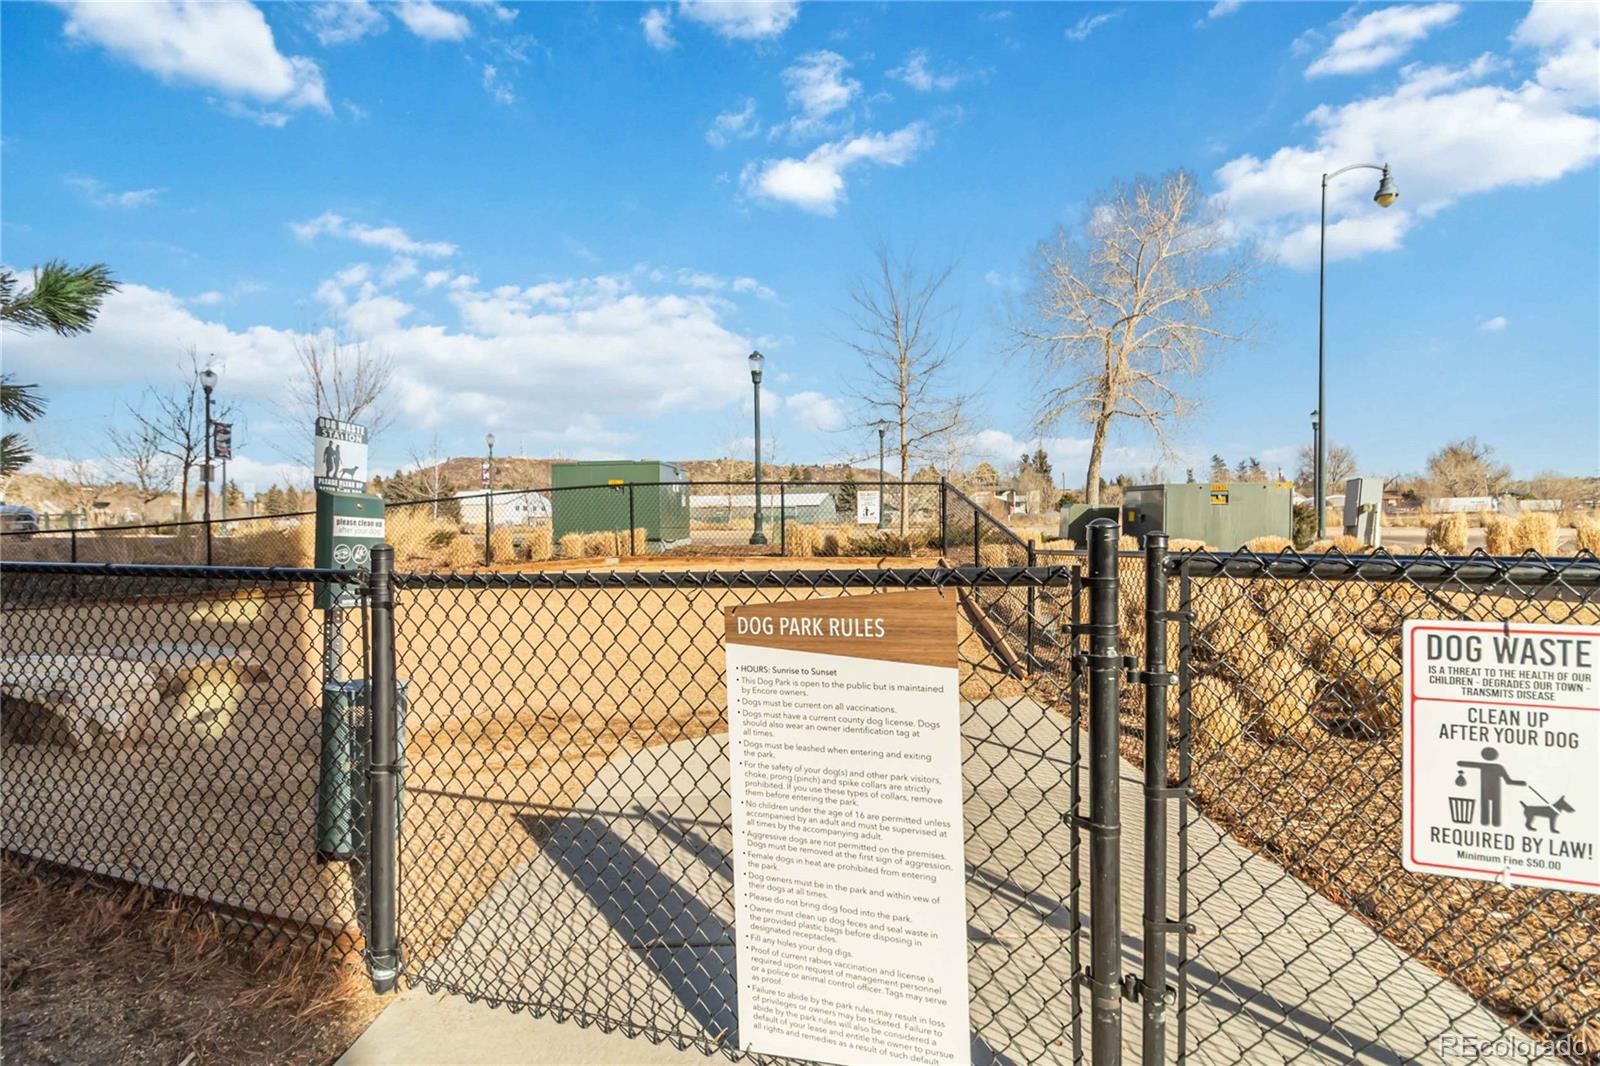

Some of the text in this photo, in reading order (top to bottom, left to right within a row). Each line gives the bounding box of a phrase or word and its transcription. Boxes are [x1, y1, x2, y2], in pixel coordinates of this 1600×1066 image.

[322, 429, 362, 443] STATION
[737, 616, 885, 638] DOG PARK RULES
[1426, 634, 1592, 668] DOG WASTE
[757, 678, 774, 687] Dog
[1439, 666, 1445, 675] A
[1448, 666, 1481, 676] THREAT
[1484, 668, 1496, 677] TO
[1499, 669, 1516, 678] THE
[1519, 670, 1554, 680] HEALTH
[1557, 672, 1569, 681] OF
[1572, 673, 1591, 682] OUR
[741, 687, 751, 695] by
[1429, 676, 1473, 686] CHILDREN
[1482, 678, 1531, 689] DEGRADES
[1534, 681, 1553, 690] OUR
[1556, 682, 1584, 692] TOWN
[742, 698, 761, 707] Dogs
[1462, 687, 1556, 701] TRANSMITS DISEASE
[742, 710, 762, 719] Dogs
[866, 717, 883, 726] dog
[885, 718, 916, 727] license.
[918, 721, 941, 729] Dogs
[1468, 708, 1549, 728] CLEAN UP
[1439, 724, 1579, 749] AFTER YOUR DOG
[743, 740, 763, 749] Dogs
[795, 744, 826, 752] leashed
[850, 749, 884, 758] entering
[904, 753, 932, 762] exiting
[771, 764, 793, 773] safety
[822, 768, 848, 778] dog(s)
[758, 802, 788, 811] children
[881, 816, 922, 825] permitted
[747, 831, 787, 841] Aggressive
[789, 835, 808, 845] dogs
[838, 843, 877, 852] permitted
[1430, 827, 1592, 860] REQUIRED BY LAW!
[1457, 851, 1561, 870] Minimum Fine $50.00
[749, 892, 772, 902] Please
[800, 900, 821, 910] bring
[822, 903, 838, 913] dog
[840, 906, 858, 915] food
[860, 909, 876, 917] into
[750, 923, 791, 935] designated
[762, 938, 776, 946] any
[777, 939, 797, 948] holes
[817, 946, 833, 955] dog
[750, 957, 782, 966] required
[805, 966, 834, 976] request
[845, 973, 898, 987] management
[900, 983, 942, 994] personnel
[752, 1005, 774, 1014] abide
[775, 1008, 784, 1017] by
[786, 1010, 798, 1018] the
[818, 1018, 837, 1026] rules
[853, 1024, 870, 1032] also
[883, 1031, 930, 1044] considered
